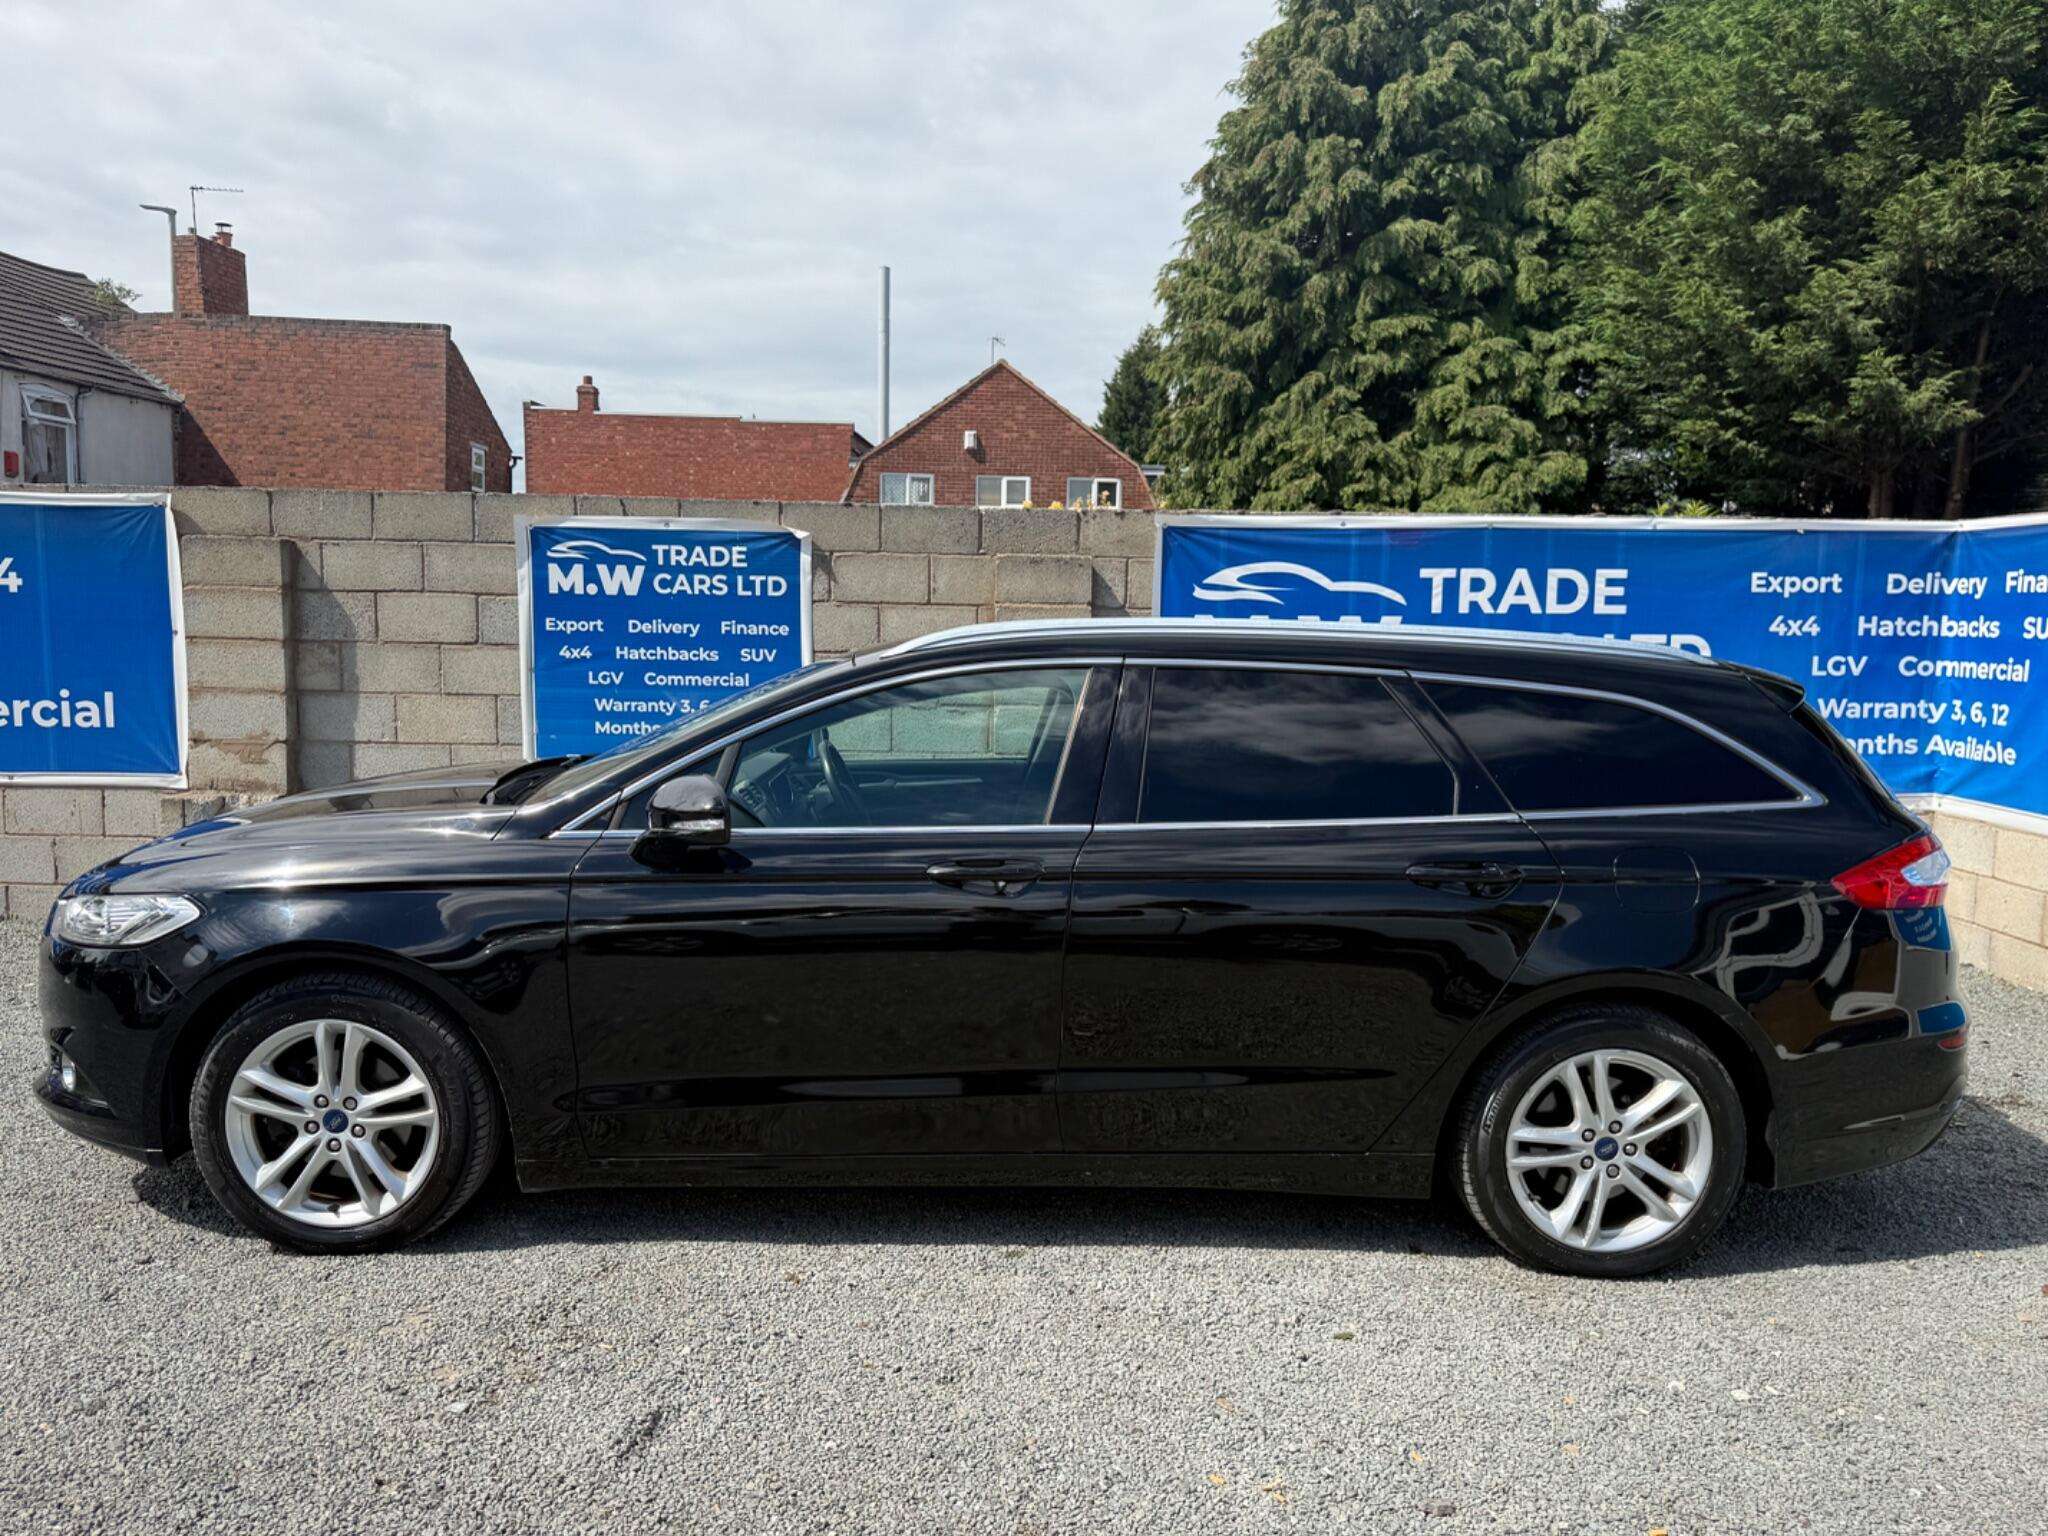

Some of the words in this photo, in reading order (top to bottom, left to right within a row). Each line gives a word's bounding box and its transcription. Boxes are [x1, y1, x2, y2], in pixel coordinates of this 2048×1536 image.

[651, 544, 748, 568] TRADE
[547, 563, 645, 596] M.W
[653, 573, 728, 596] CARS
[737, 575, 787, 597] LTD
[1419, 567, 1628, 615] TRADE
[1751, 571, 1842, 598] Export
[1886, 572, 1988, 600] Delivery
[545, 617, 603, 634] Export
[628, 619, 700, 637] Delivery
[721, 620, 790, 636] Finance
[1769, 615, 1821, 636] 4x4
[1858, 614, 2000, 639] Hatchbacks
[559, 645, 592, 659] 4x4
[616, 646, 719, 662] Hatchbacks
[740, 648, 777, 662] SUV
[588, 671, 624, 685] LGV
[644, 672, 749, 687] Commercial
[1811, 655, 1868, 676] LGV
[1898, 655, 2030, 682] Commercial
[594, 698, 677, 716] Warranty
[1817, 698, 1947, 724] Warranty
[1951, 699, 1967, 725] 3,
[1970, 701, 1987, 727] 6,
[1991, 703, 2010, 726] 12
[1925, 734, 2017, 766] Available
